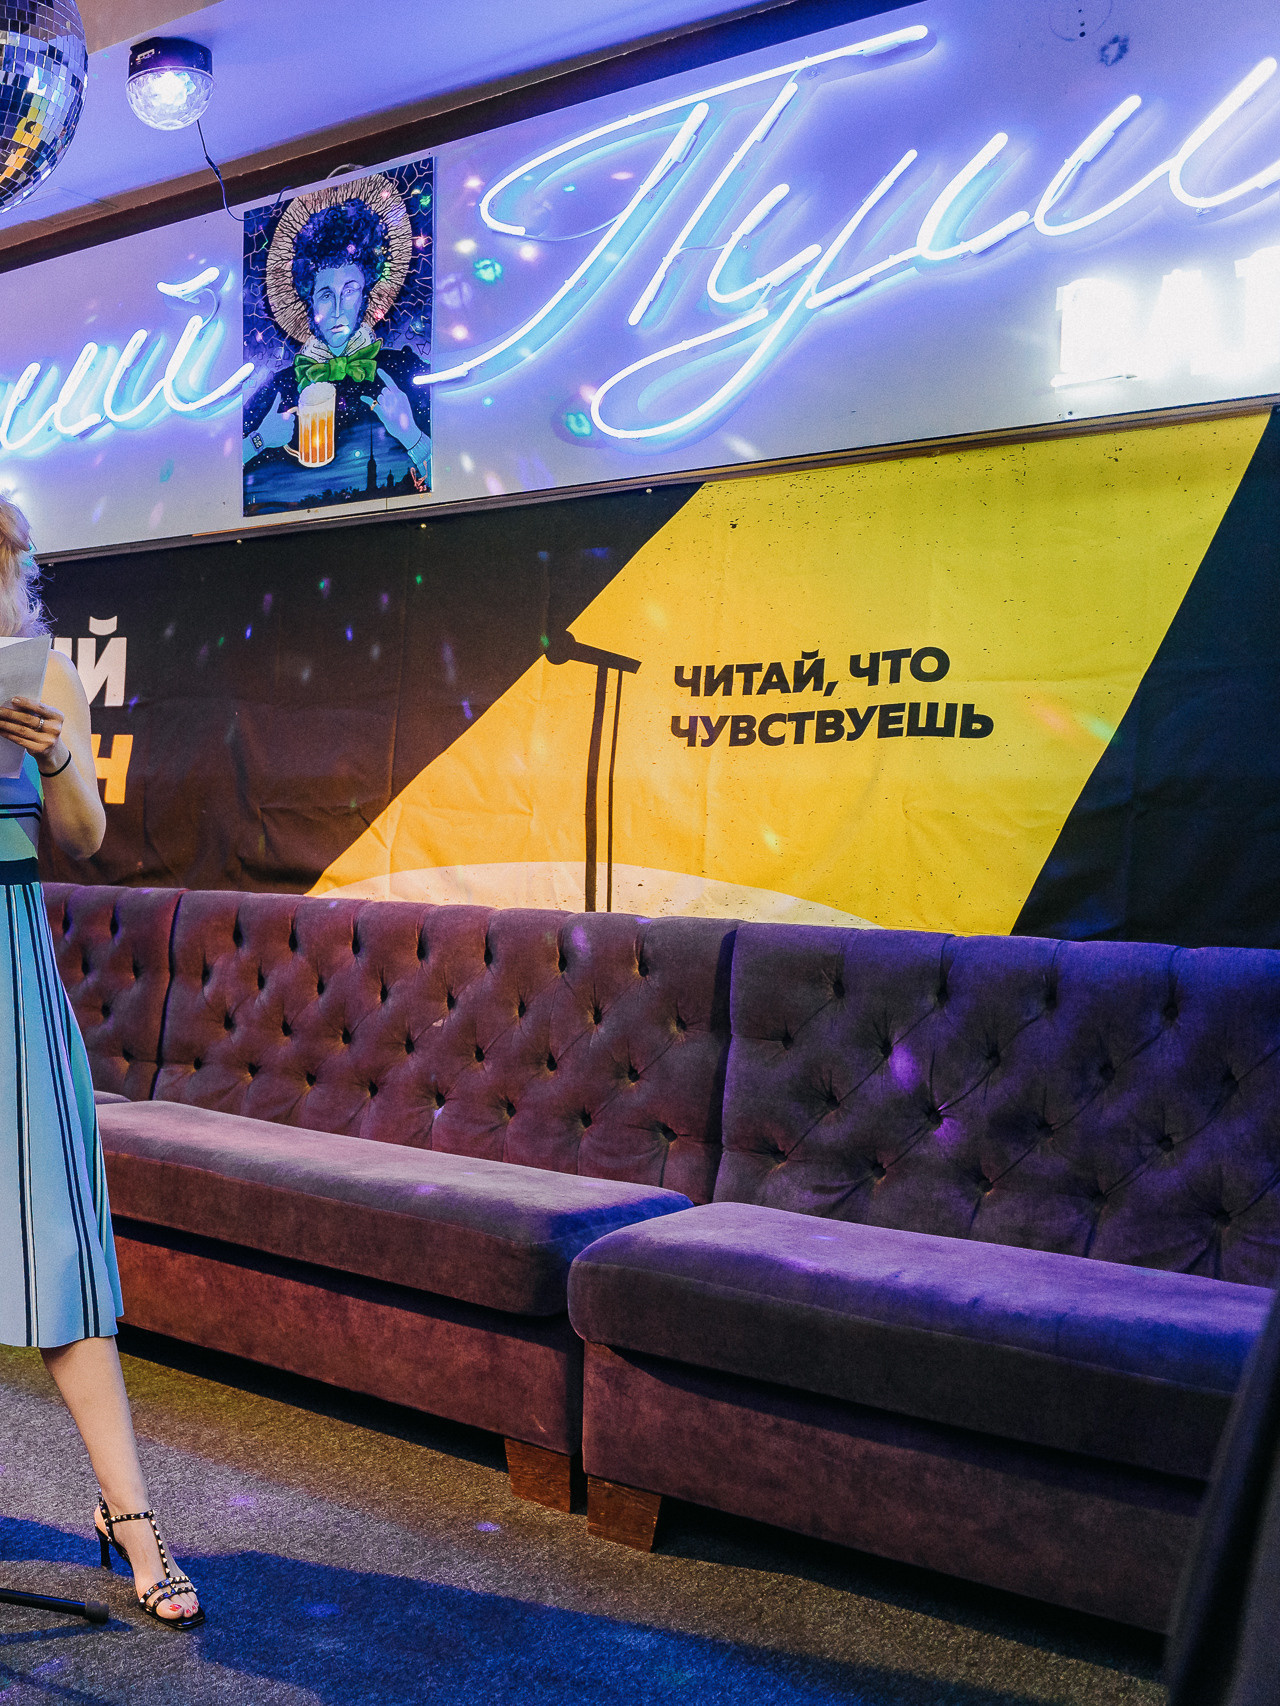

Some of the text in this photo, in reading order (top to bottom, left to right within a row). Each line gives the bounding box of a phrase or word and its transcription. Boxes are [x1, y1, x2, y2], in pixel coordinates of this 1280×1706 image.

[674, 647, 950, 697] ЧИТАЙ, ЧТО
[671, 702, 994, 747] ЧУВСТВУЕШЬ
